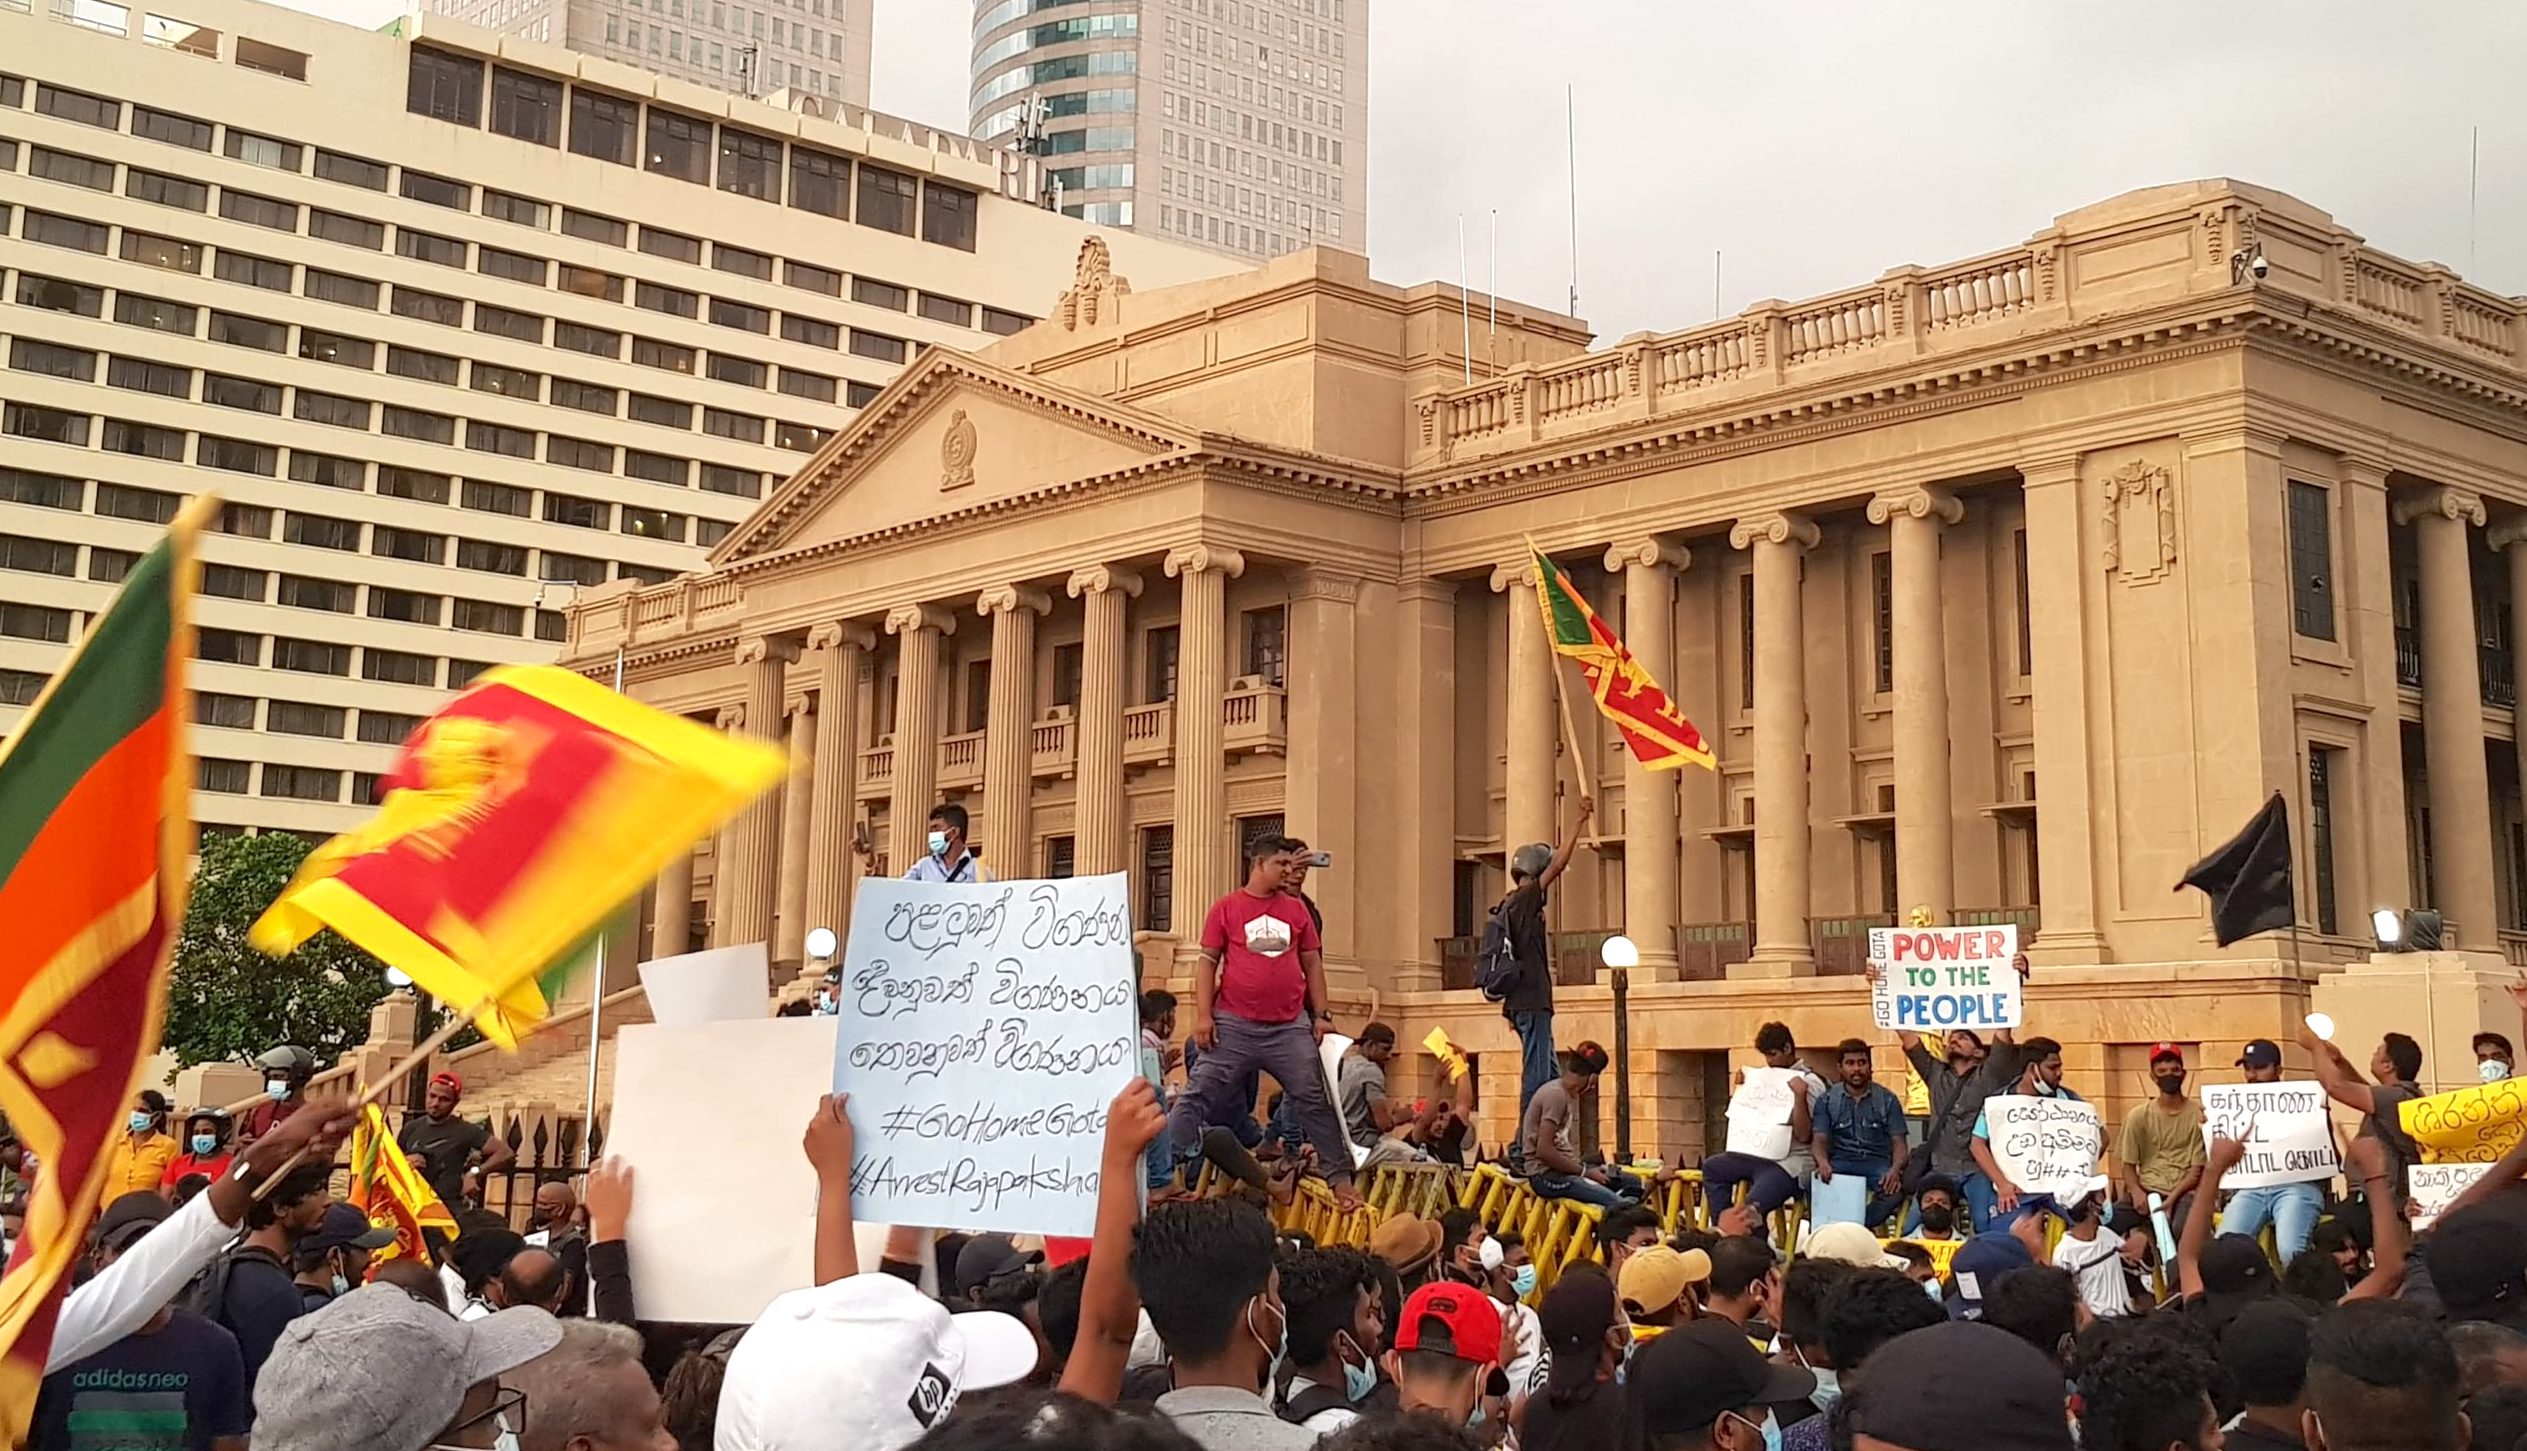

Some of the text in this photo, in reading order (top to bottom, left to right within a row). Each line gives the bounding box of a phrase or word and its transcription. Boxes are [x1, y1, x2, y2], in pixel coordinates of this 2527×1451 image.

[1872, 930, 1887, 960] GOTA
[1893, 930, 2006, 962] POWER
[1905, 965, 1991, 987] TO THE
[1896, 992, 2009, 1026] PEOPLE
[73, 1368, 190, 1389] adidasneo
[918, 1380, 941, 1411] hp
